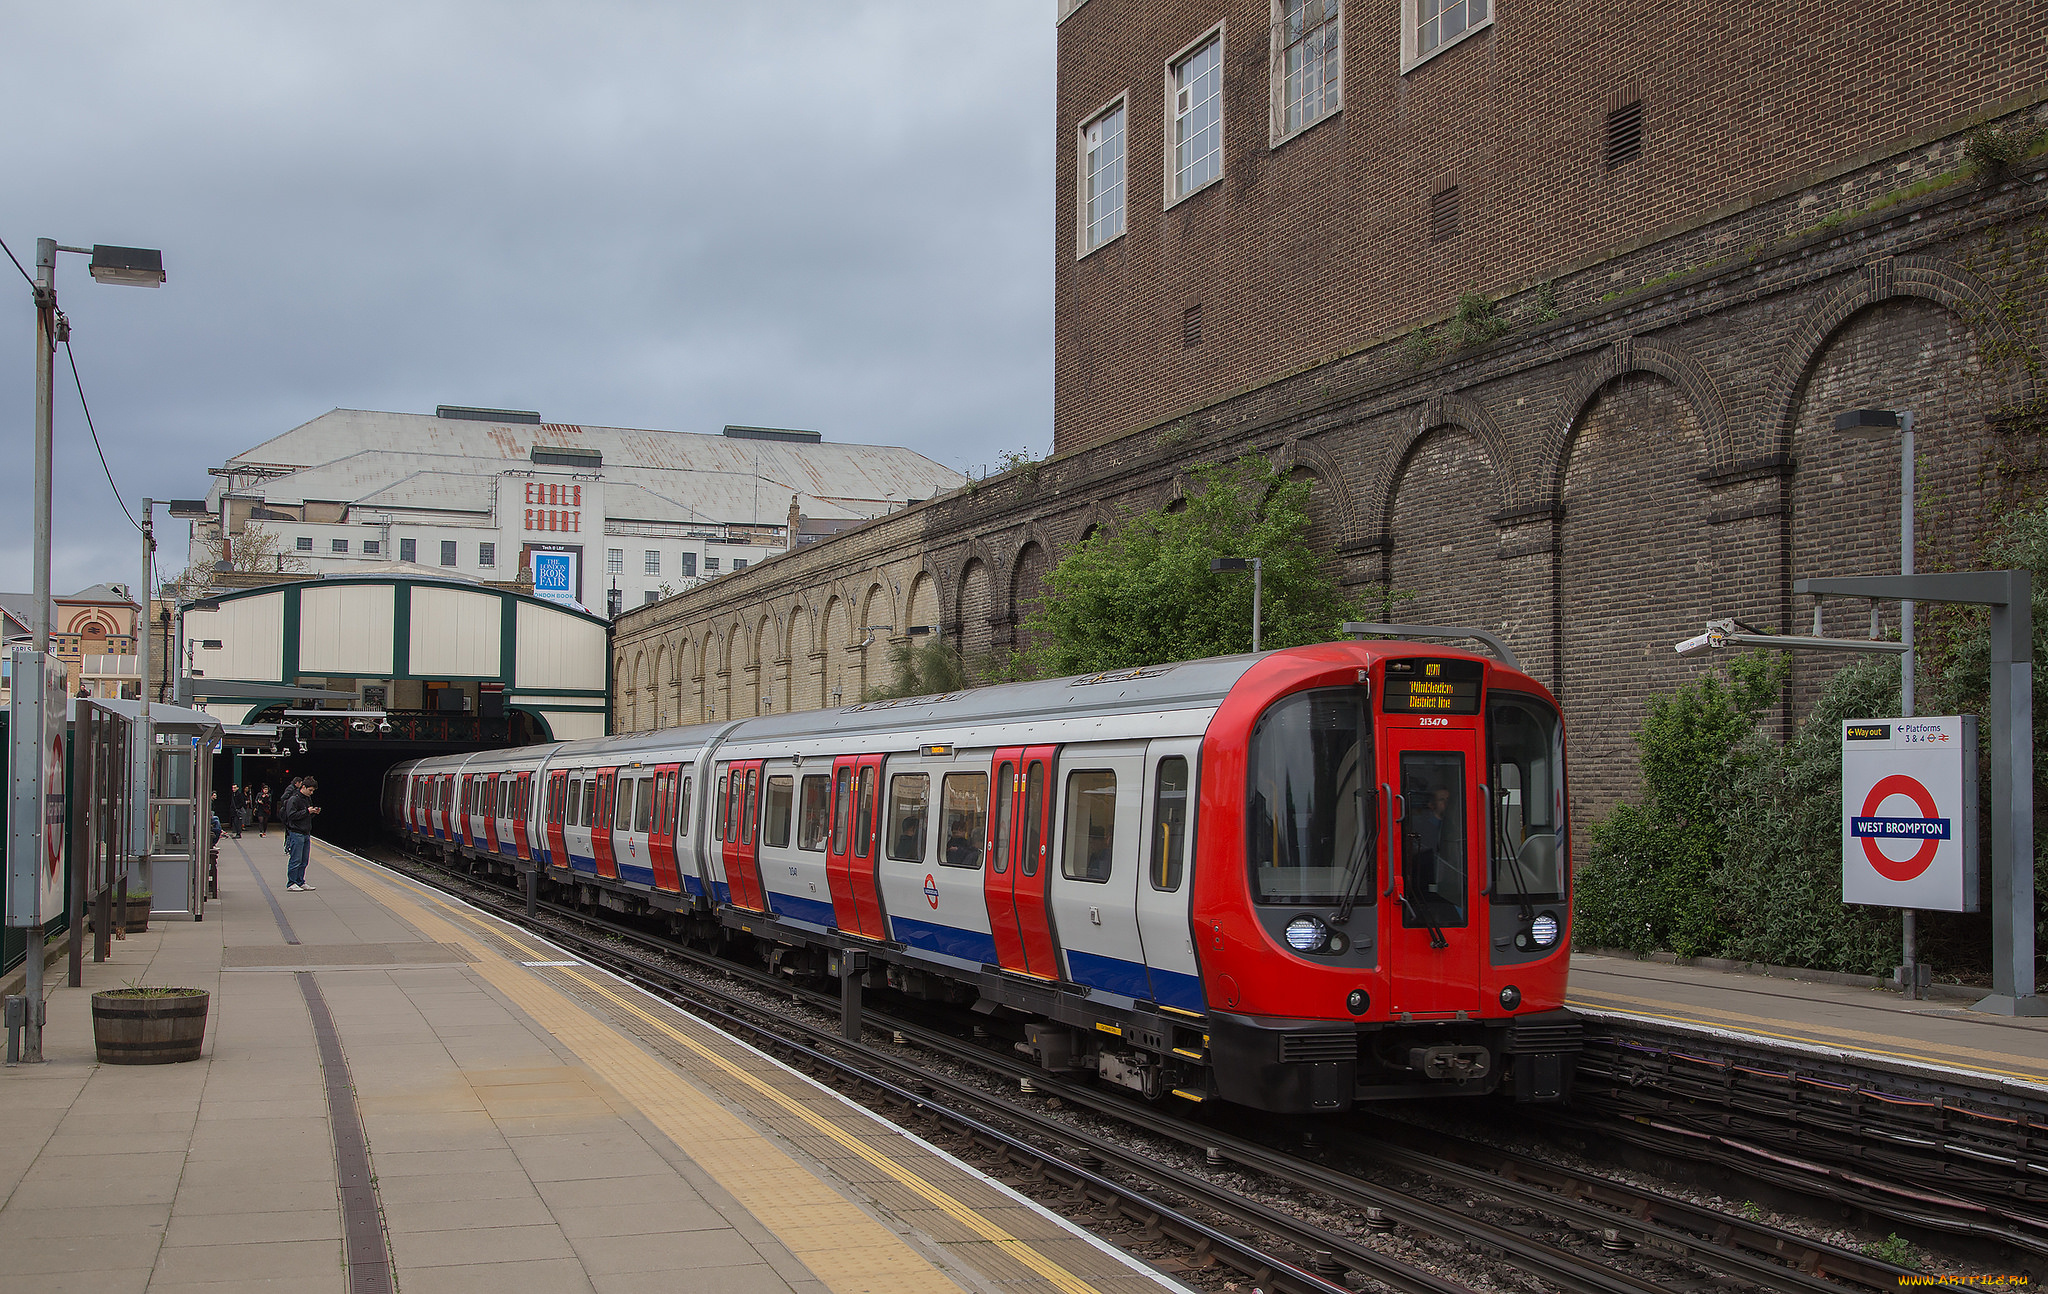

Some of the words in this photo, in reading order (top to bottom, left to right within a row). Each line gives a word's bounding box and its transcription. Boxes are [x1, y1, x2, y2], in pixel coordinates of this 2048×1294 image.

[525, 482, 581, 506] EARLS
[525, 508, 580, 532] COURT
[540, 569, 566, 578] BOOK
[539, 577, 566, 587] FAIR
[1409, 695, 1437, 708] District
[1419, 718, 1441, 726] 21347
[1854, 728, 1869, 738] Way
[1869, 728, 1882, 736] out
[1905, 724, 1941, 733] Platforms
[1857, 821, 1884, 833] WEST
[1886, 822, 1943, 834] BROMPTON
